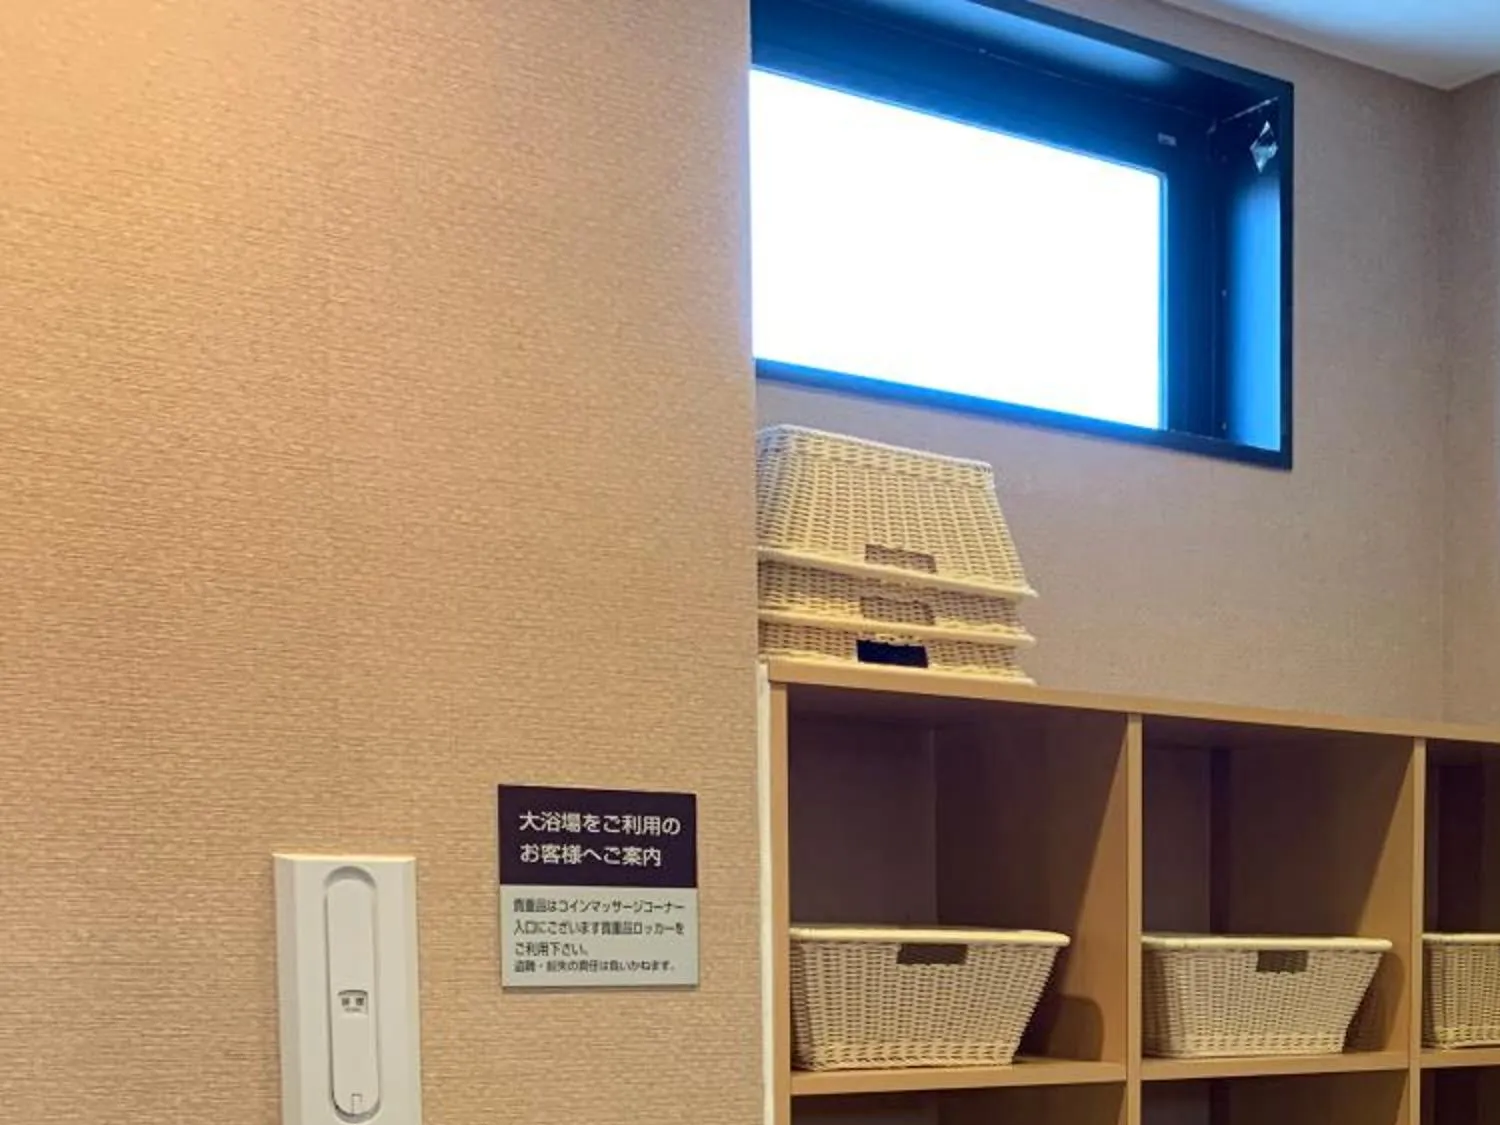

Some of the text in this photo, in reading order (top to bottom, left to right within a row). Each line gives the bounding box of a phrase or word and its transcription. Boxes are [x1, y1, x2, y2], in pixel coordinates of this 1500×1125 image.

[518, 810, 681, 835] 大浴場をご利用の
[519, 843, 662, 867] お客様へご案内
[513, 897, 686, 914] 貴重品はコインマッサージコーナー
